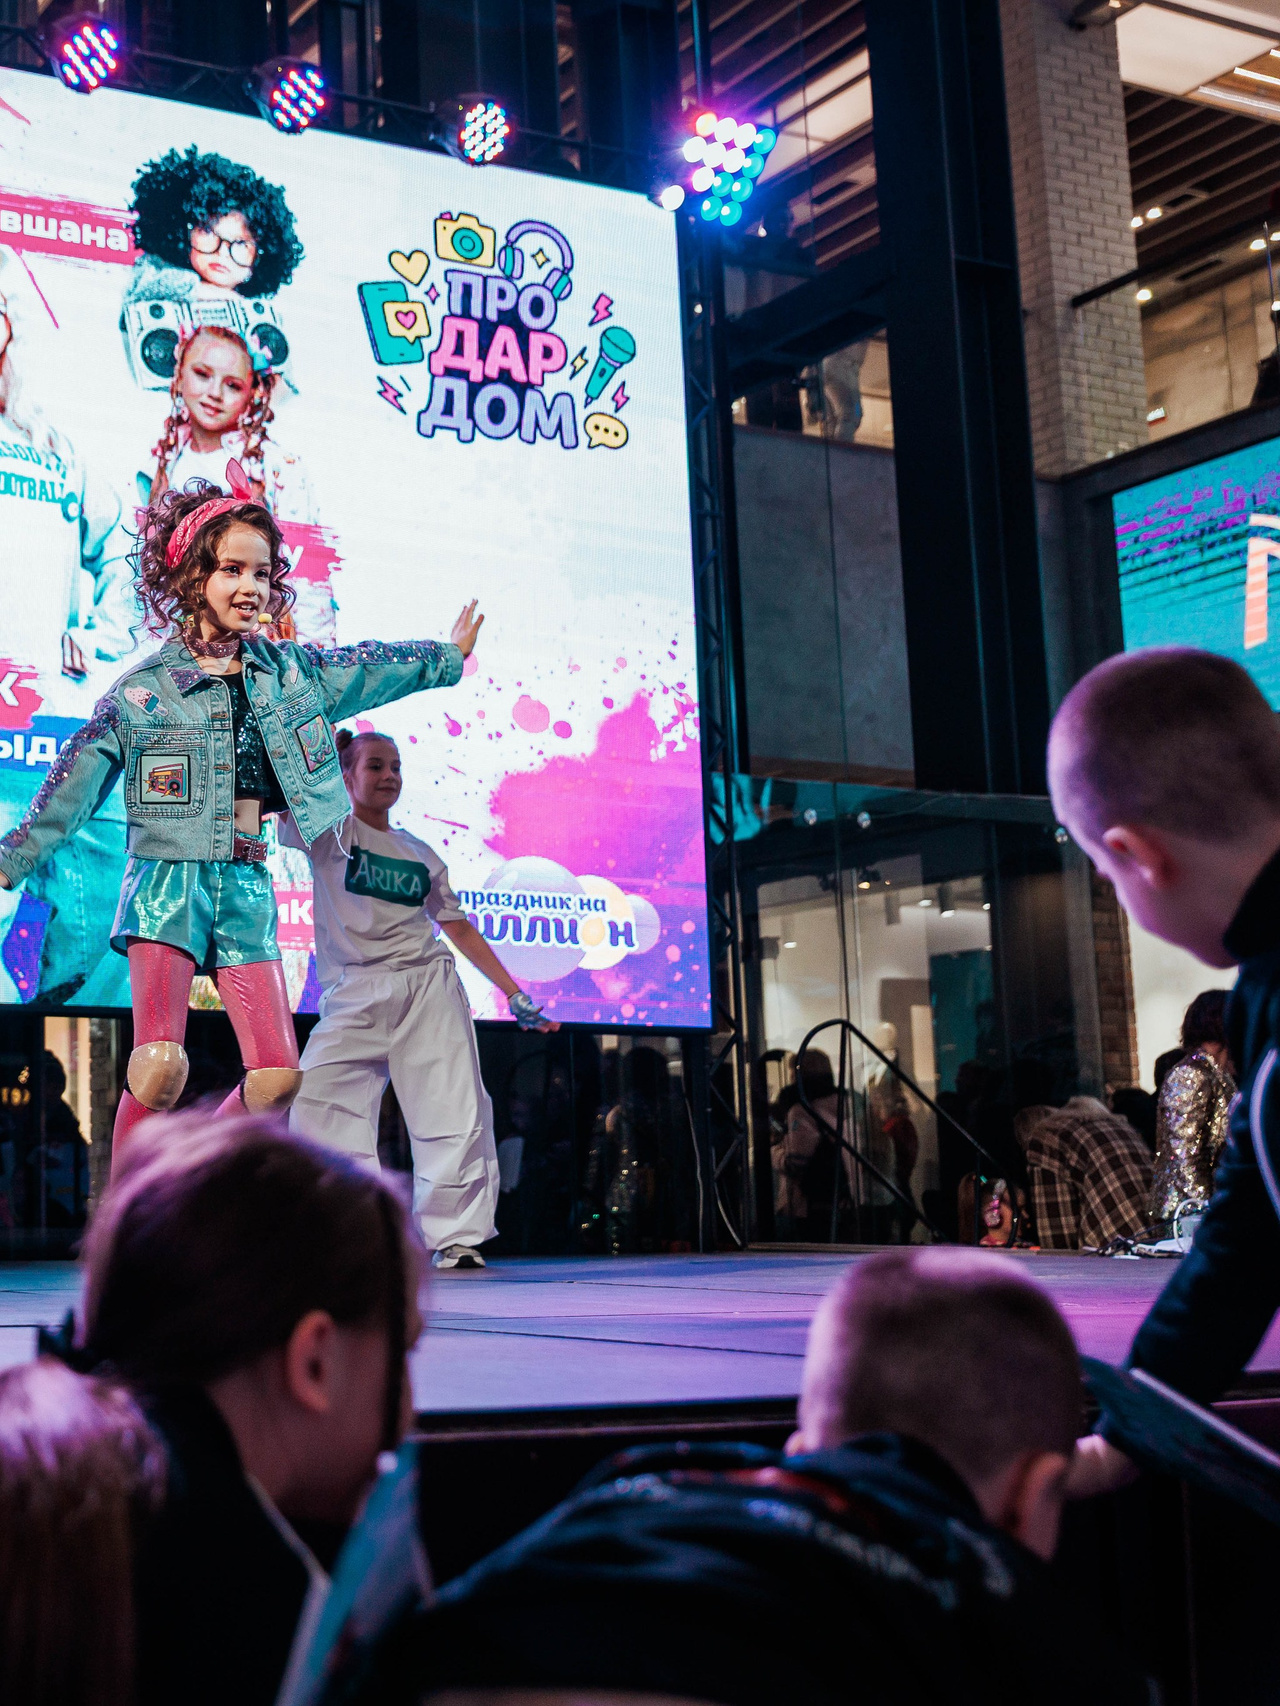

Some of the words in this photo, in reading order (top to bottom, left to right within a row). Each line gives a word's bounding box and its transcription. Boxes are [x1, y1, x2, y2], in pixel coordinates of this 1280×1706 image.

[444, 268, 558, 331] ПРО
[428, 314, 569, 387] ДАР
[416, 374, 579, 450] ДОМ
[349, 852, 424, 897] ARIKA
[457, 889, 572, 912] праздник
[578, 896, 607, 912] на
[433, 912, 636, 948] иллион
